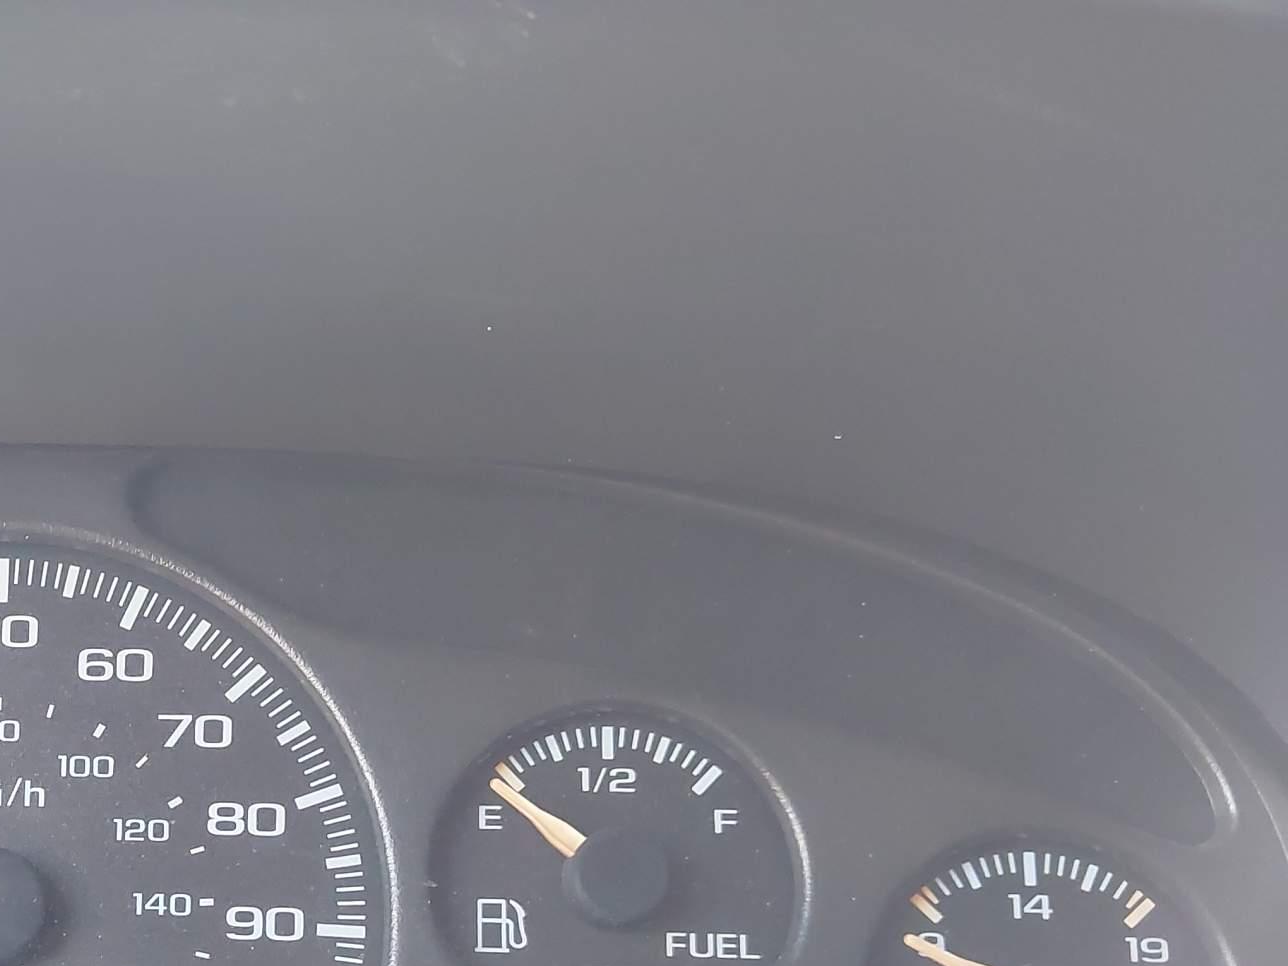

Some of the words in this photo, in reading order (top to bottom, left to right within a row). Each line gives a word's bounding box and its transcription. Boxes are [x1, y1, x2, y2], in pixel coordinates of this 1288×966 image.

[77, 648, 154, 682] 60
[157, 714, 234, 749] 70
[59, 754, 114, 778] 100
[578, 767, 637, 793] 1/2
[113, 818, 170, 843] 120
[207, 803, 287, 837] 80
[479, 805, 503, 830] E
[714, 809, 738, 834] F
[133, 892, 193, 918] 140
[1008, 894, 1053, 920] 14
[225, 906, 305, 942] 90
[665, 933, 761, 960] FUEL
[1125, 937, 1169, 963] 19
